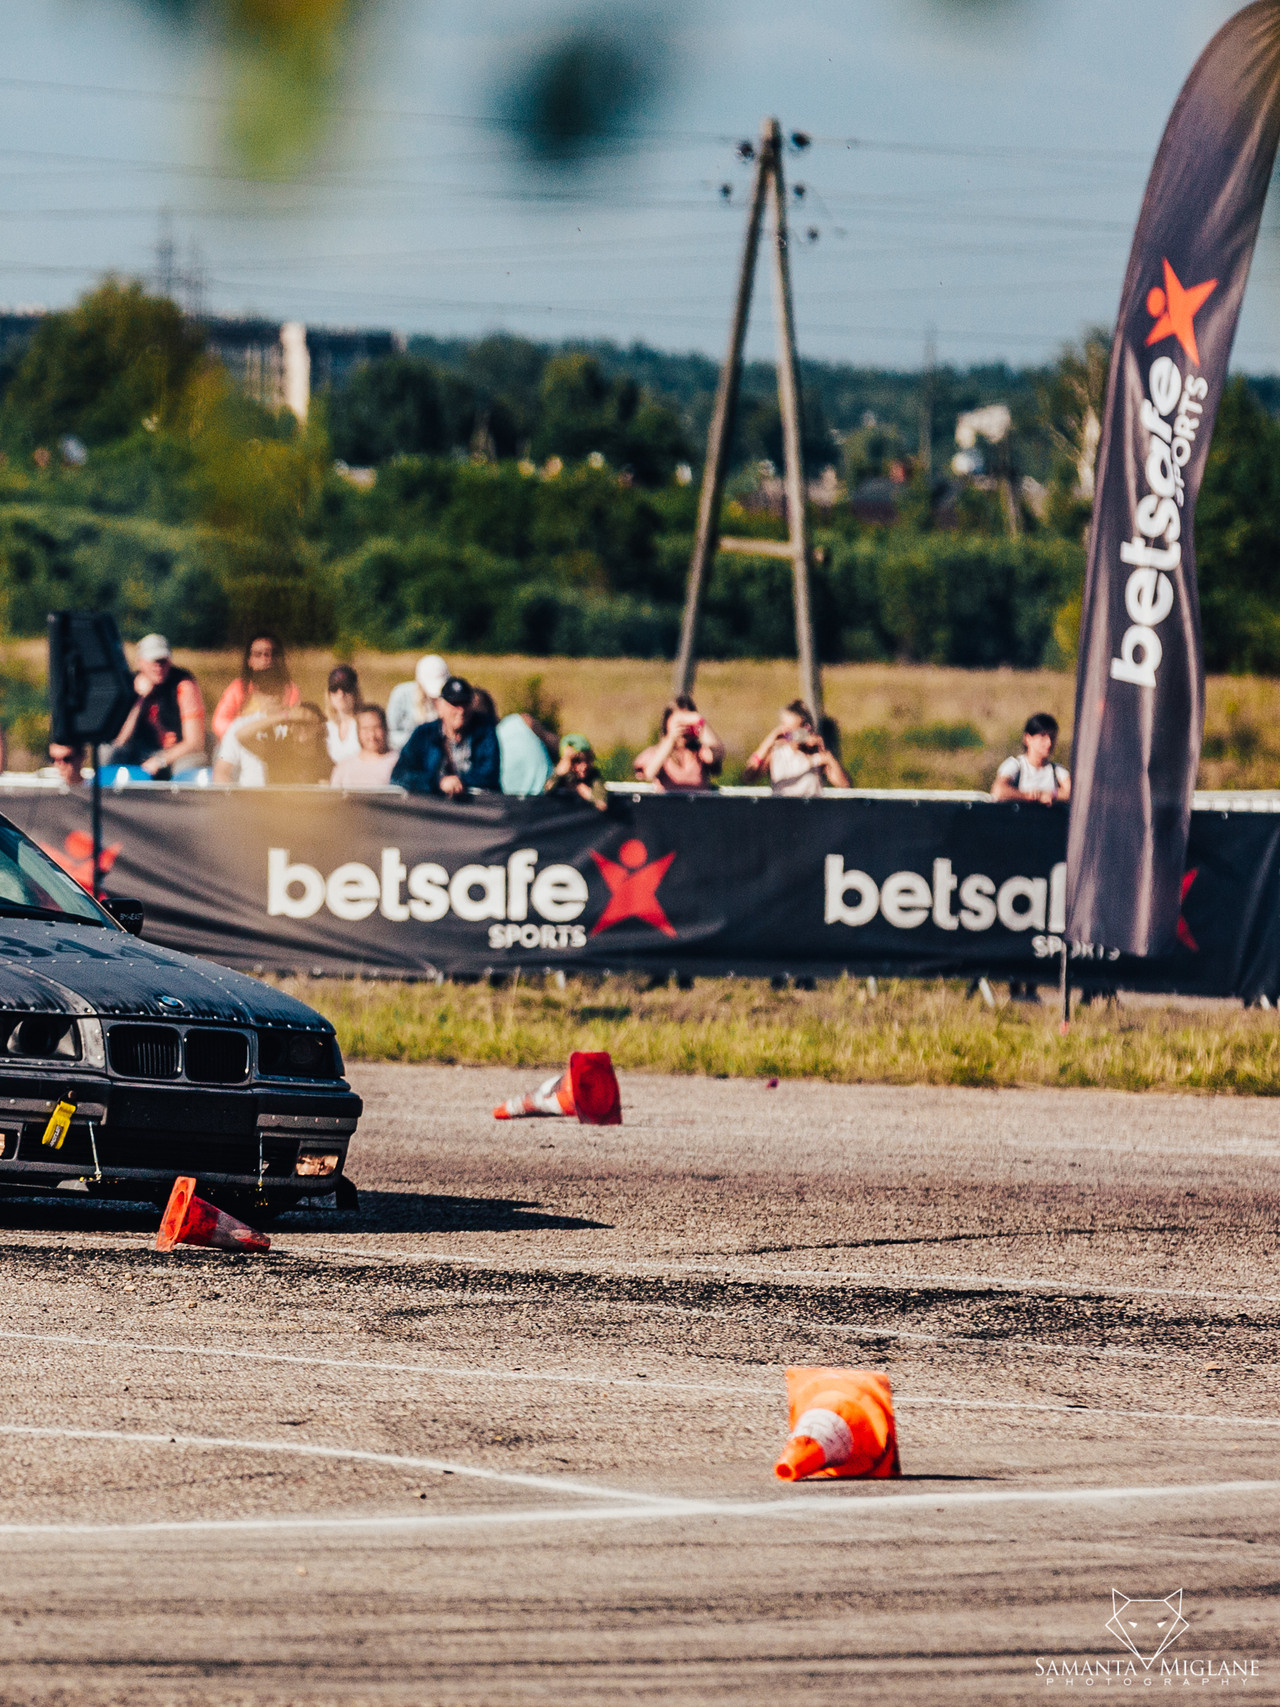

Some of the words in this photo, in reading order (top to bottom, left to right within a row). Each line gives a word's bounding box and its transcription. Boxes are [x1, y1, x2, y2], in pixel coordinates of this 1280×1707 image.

[1172, 374, 1209, 507] SPORTS
[1110, 356, 1182, 688] betsafe
[267, 847, 589, 922] betsafe
[824, 853, 1067, 932] betsaf
[487, 923, 588, 949] SPORTS
